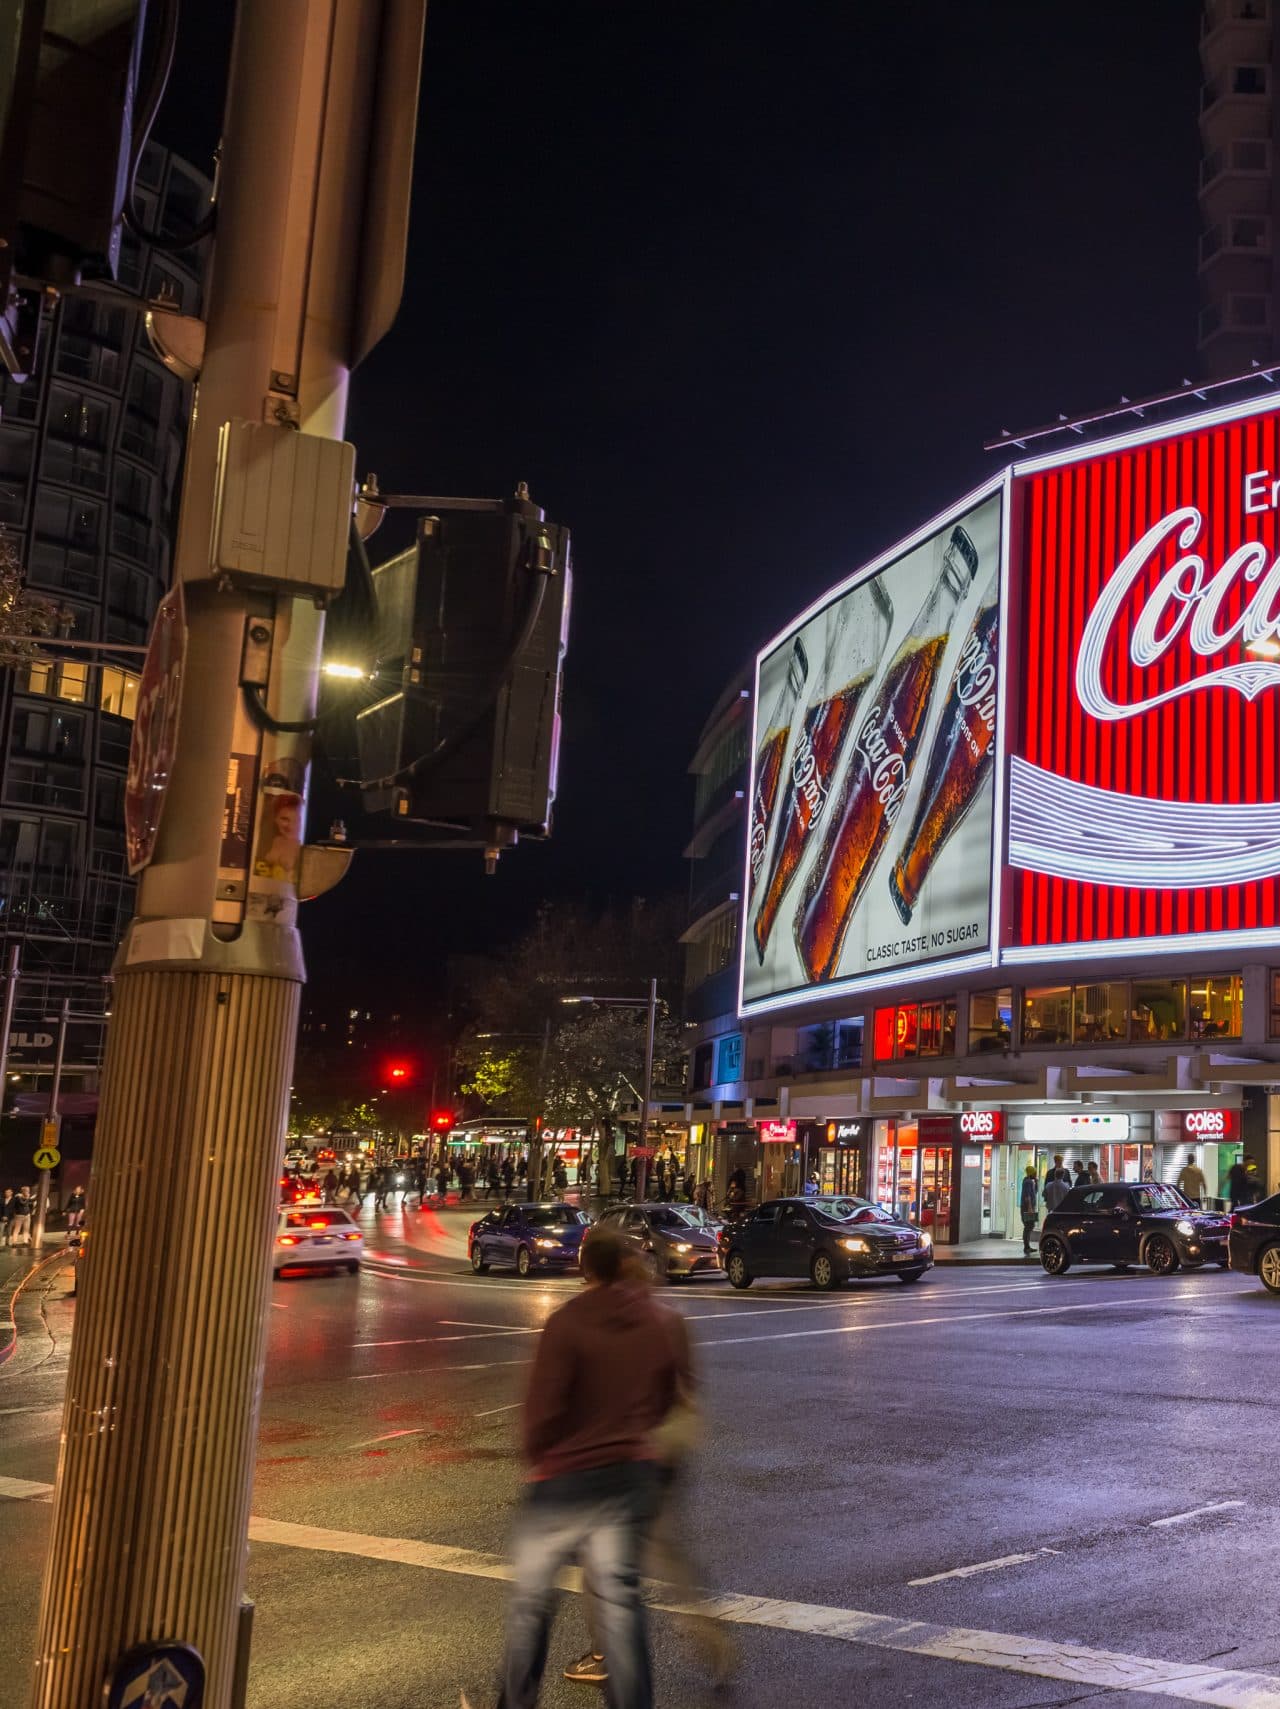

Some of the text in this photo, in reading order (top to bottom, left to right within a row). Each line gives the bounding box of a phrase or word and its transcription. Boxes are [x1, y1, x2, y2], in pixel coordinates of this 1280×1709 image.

[866, 923, 979, 962] CLASSIC TASTE, NO SUGAR
[960, 1111, 992, 1132] coles
[1186, 1110, 1224, 1132] coles
[1196, 1132, 1224, 1142] Supermarket
